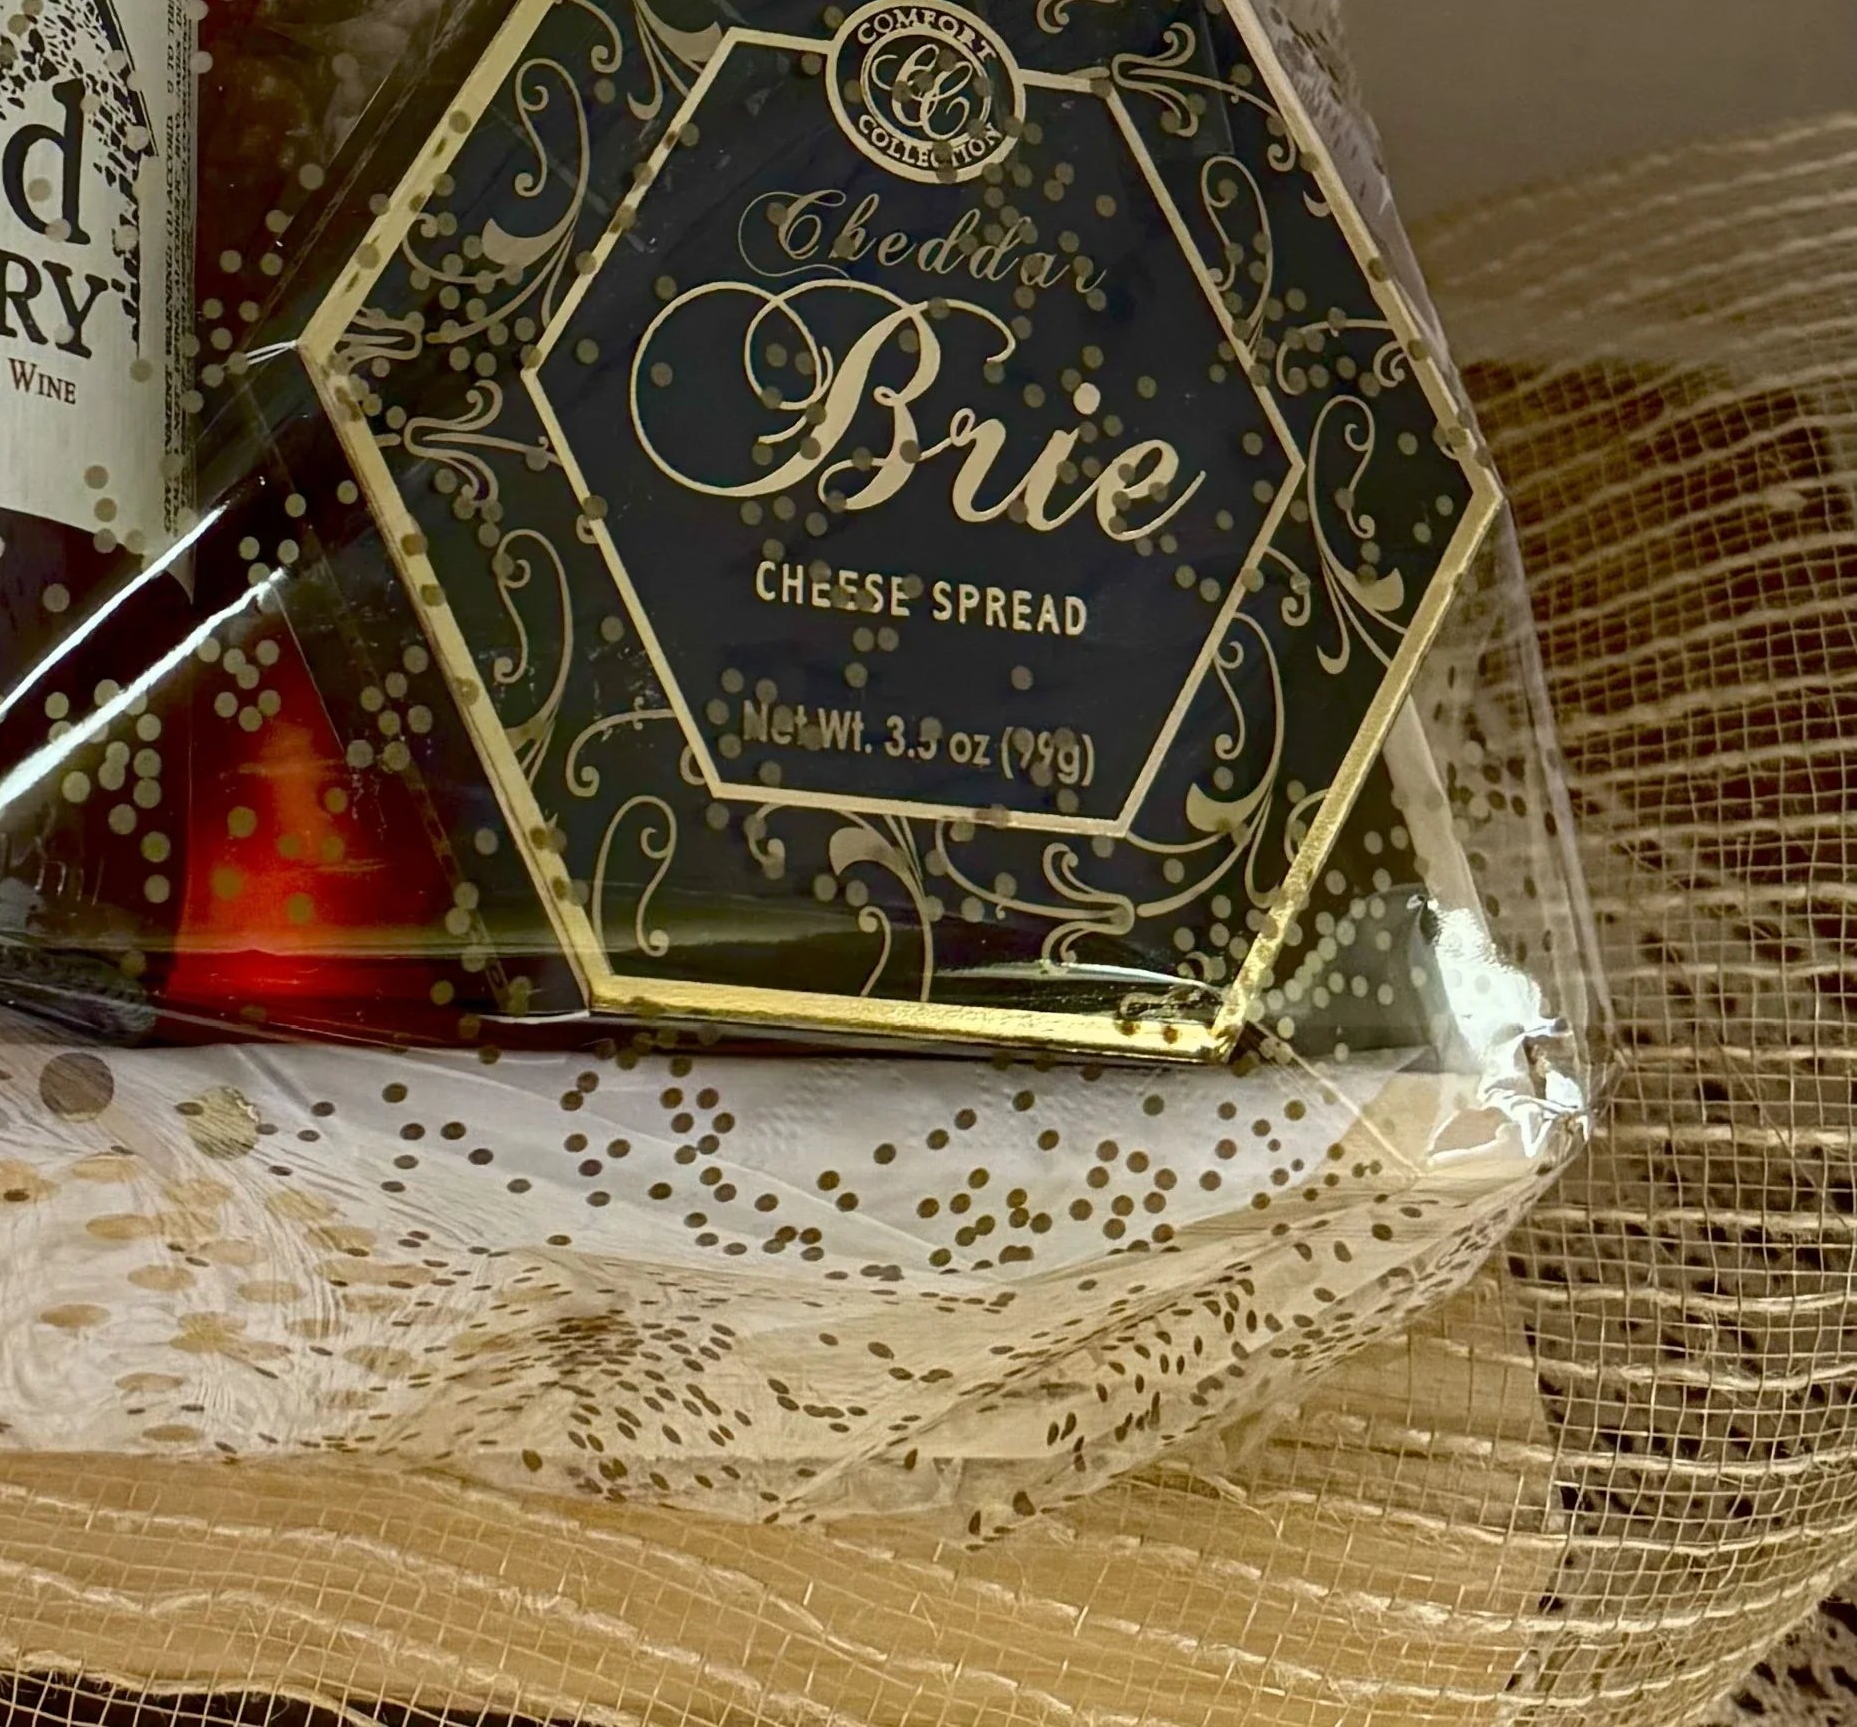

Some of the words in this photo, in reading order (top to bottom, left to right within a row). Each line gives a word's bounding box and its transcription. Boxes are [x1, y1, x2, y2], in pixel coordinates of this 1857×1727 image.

[856, 7, 997, 63] COMFORT
[858, 114, 1004, 168] COLLECTION
[738, 188, 1107, 294] Cheddar
[7, 357, 77, 405] WINE
[629, 278, 1207, 543] Brie
[755, 559, 911, 617] CHEESE
[931, 580, 1088, 636] SPREAD
[742, 699, 809, 746] Net
[817, 707, 873, 755] Wt.
[948, 730, 993, 768] oz
[1000, 726, 1095, 787] (99g)
